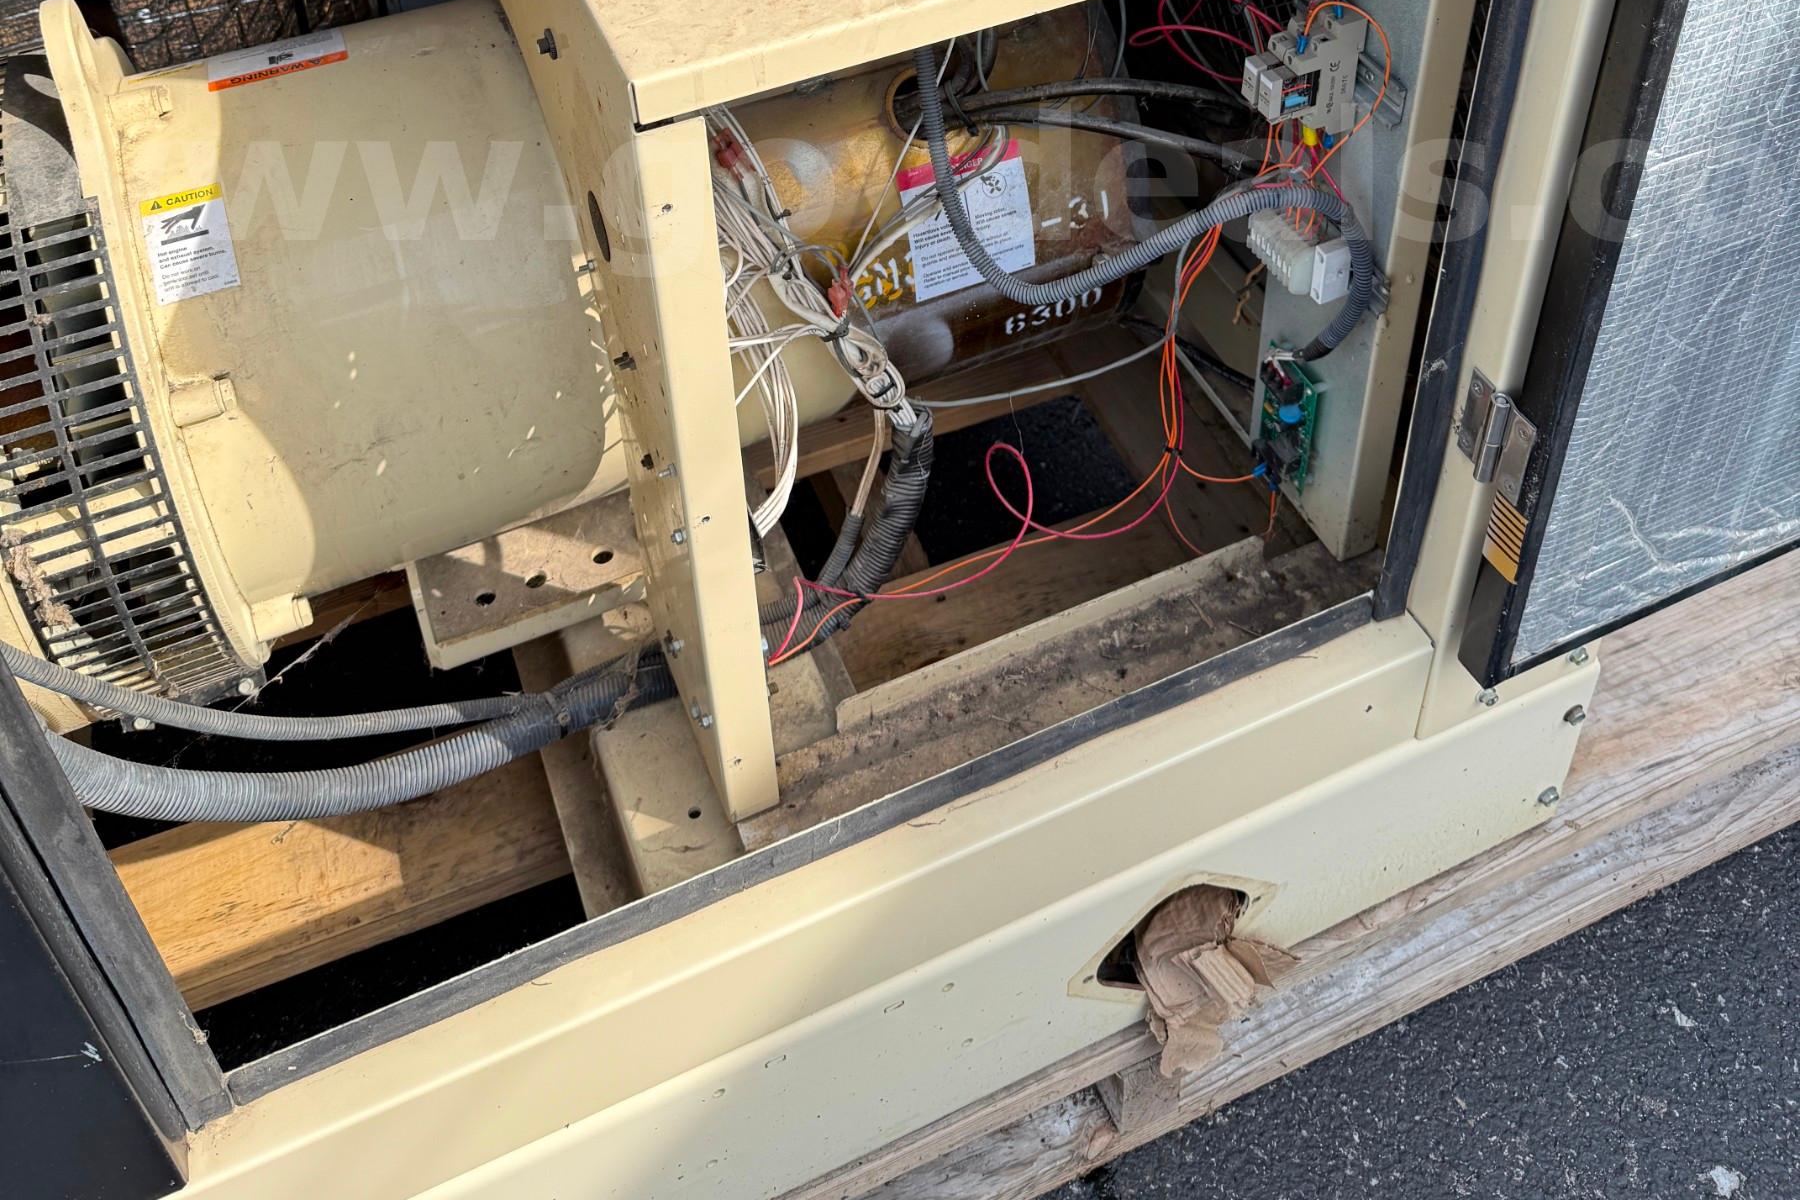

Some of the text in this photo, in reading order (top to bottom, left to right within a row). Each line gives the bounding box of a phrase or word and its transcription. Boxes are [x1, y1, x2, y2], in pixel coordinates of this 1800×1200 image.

[230, 62, 305, 85] WARNING
[165, 188, 214, 206] CAUTION
[1004, 286, 1103, 335] 6300
